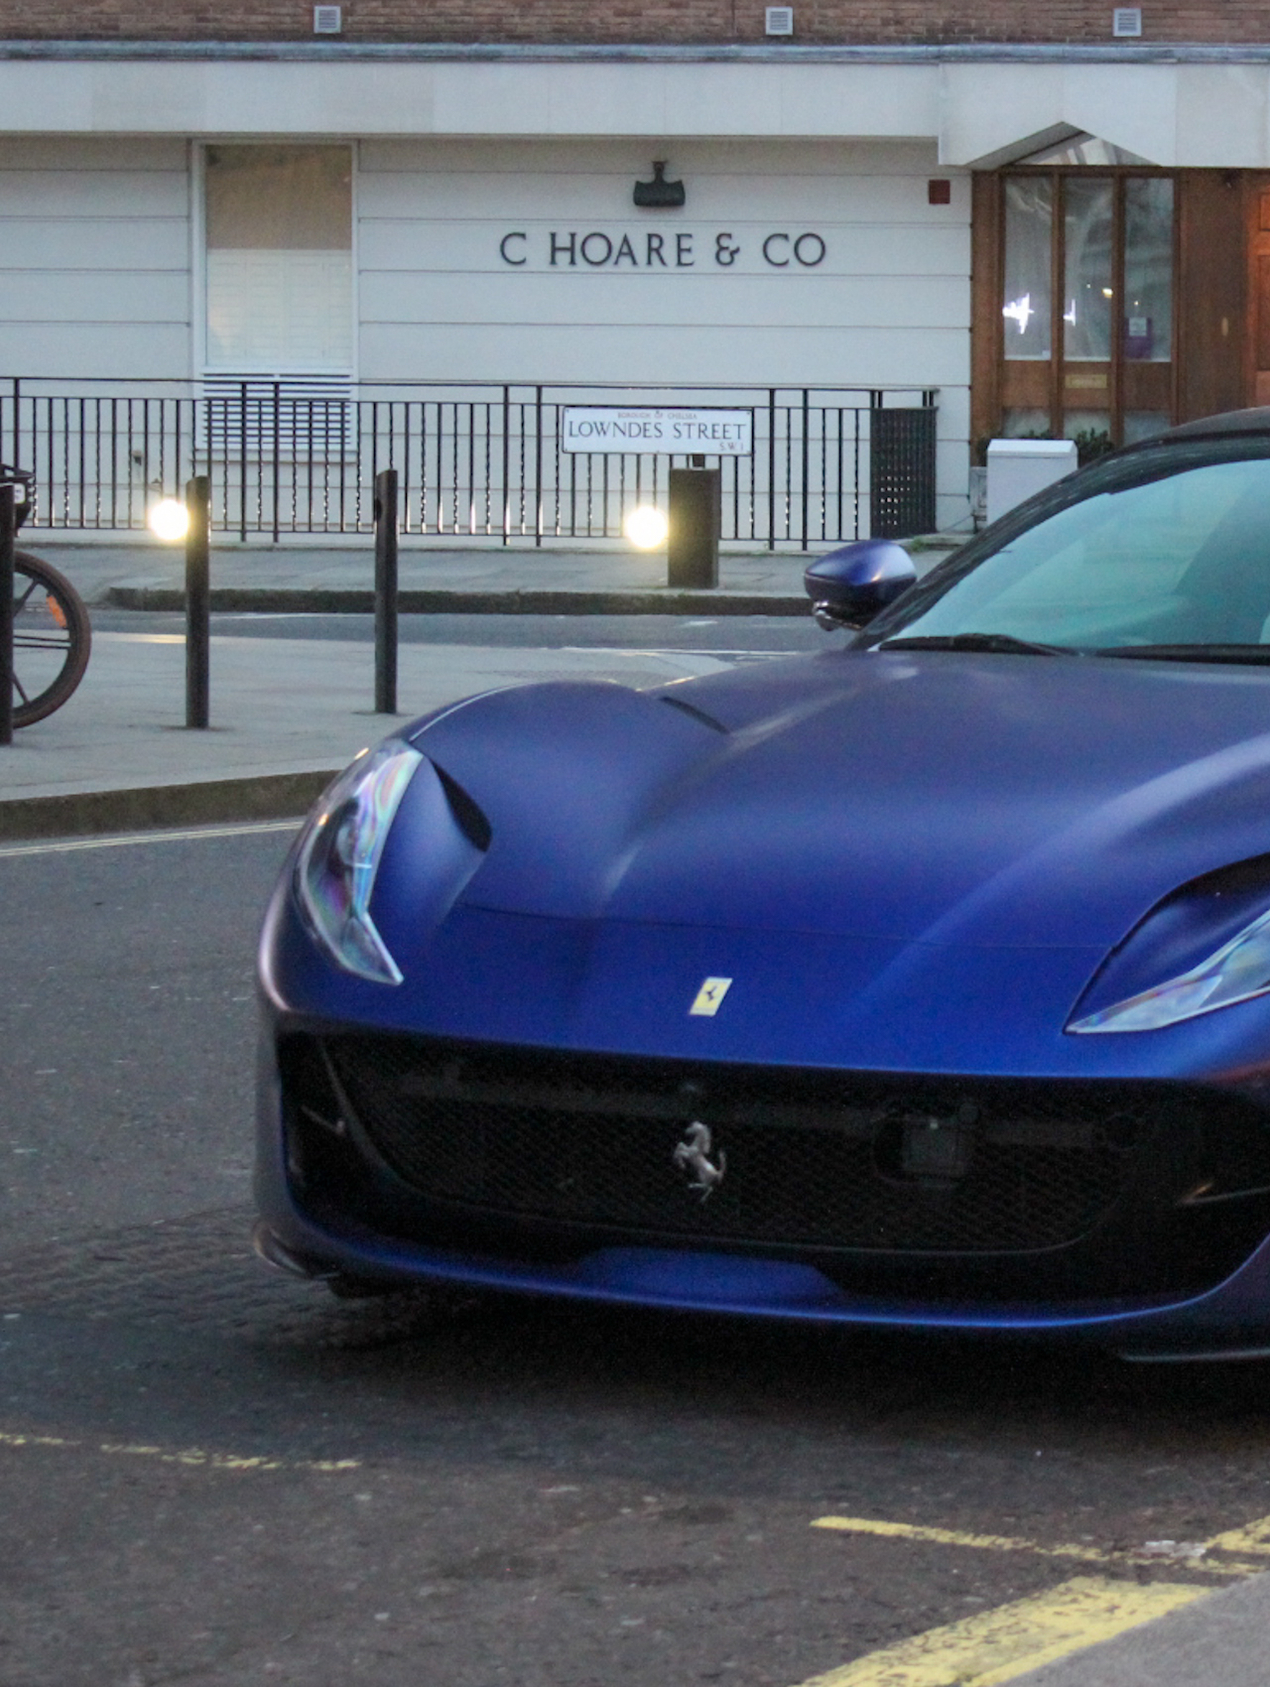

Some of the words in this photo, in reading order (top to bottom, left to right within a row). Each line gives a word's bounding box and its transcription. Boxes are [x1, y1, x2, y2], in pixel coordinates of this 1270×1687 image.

[499, 232, 527, 266] C
[549, 231, 696, 267] HOARE
[714, 232, 741, 267] &
[762, 232, 827, 267] CO
[567, 420, 664, 439] LOWNDES
[673, 422, 748, 441] STREET
